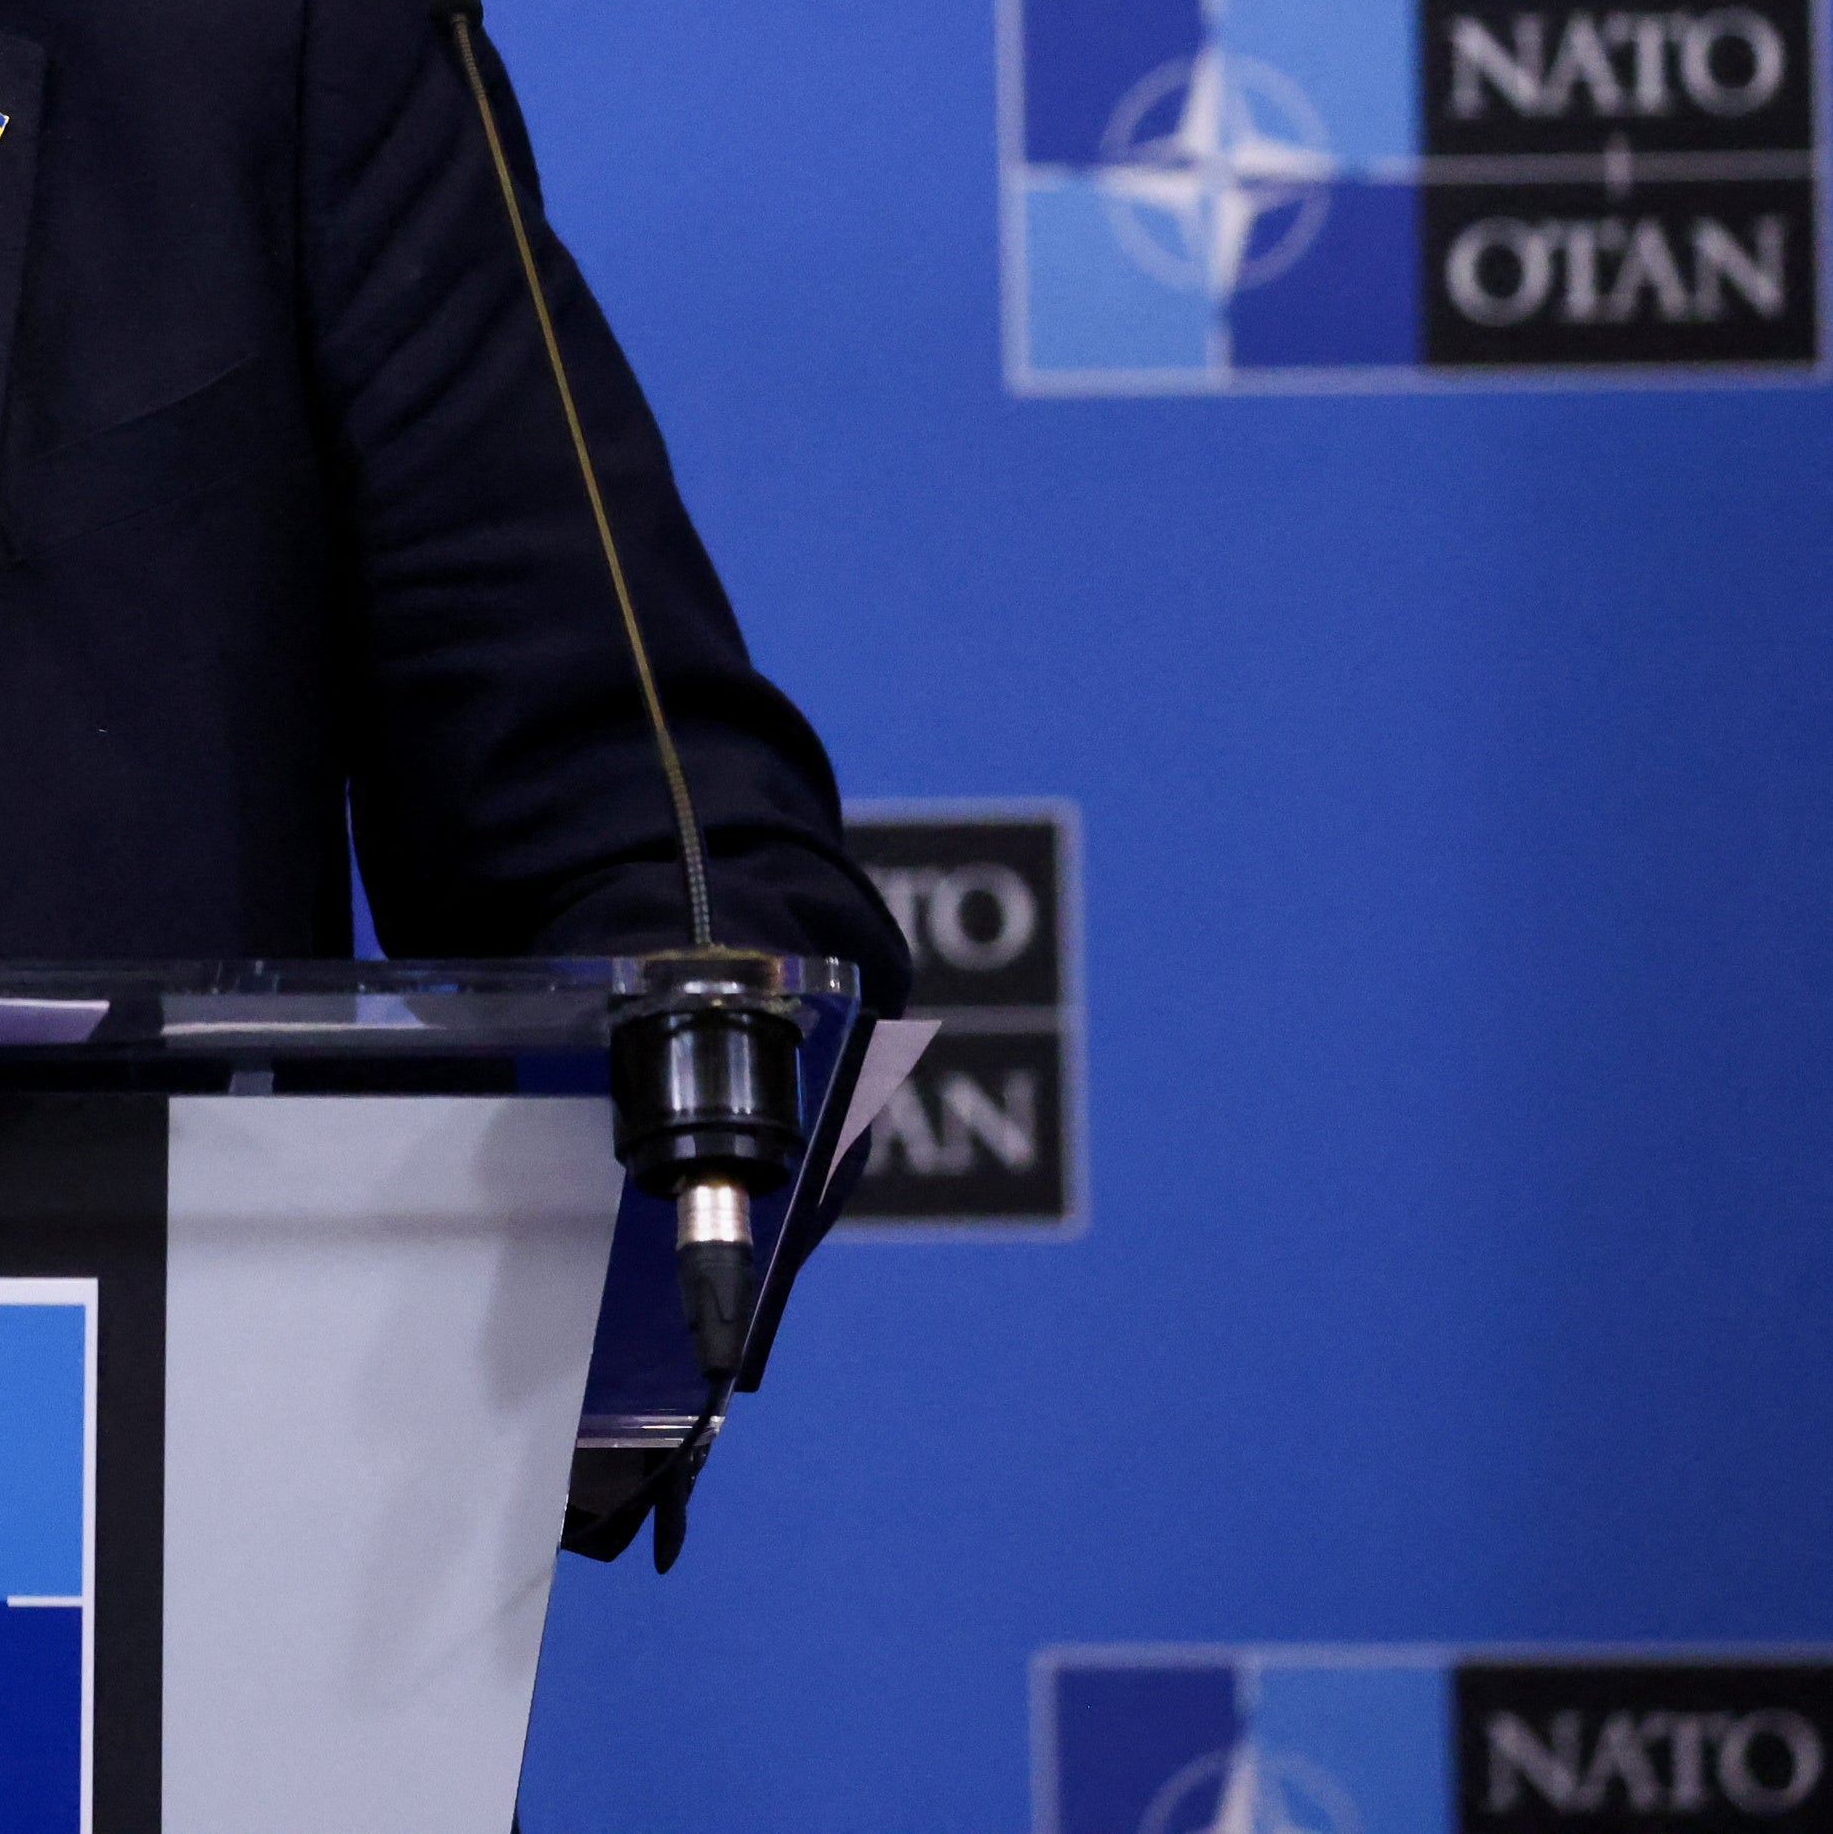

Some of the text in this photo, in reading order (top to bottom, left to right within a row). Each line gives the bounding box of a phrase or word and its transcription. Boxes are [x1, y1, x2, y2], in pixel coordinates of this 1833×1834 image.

[1449, 7, 1784, 118] NATO
[1444, 217, 1785, 326] OTAN
[865, 863, 1036, 971] TO
[864, 1071, 1036, 1176] AN
[1483, 1708, 1822, 1813] NATO
